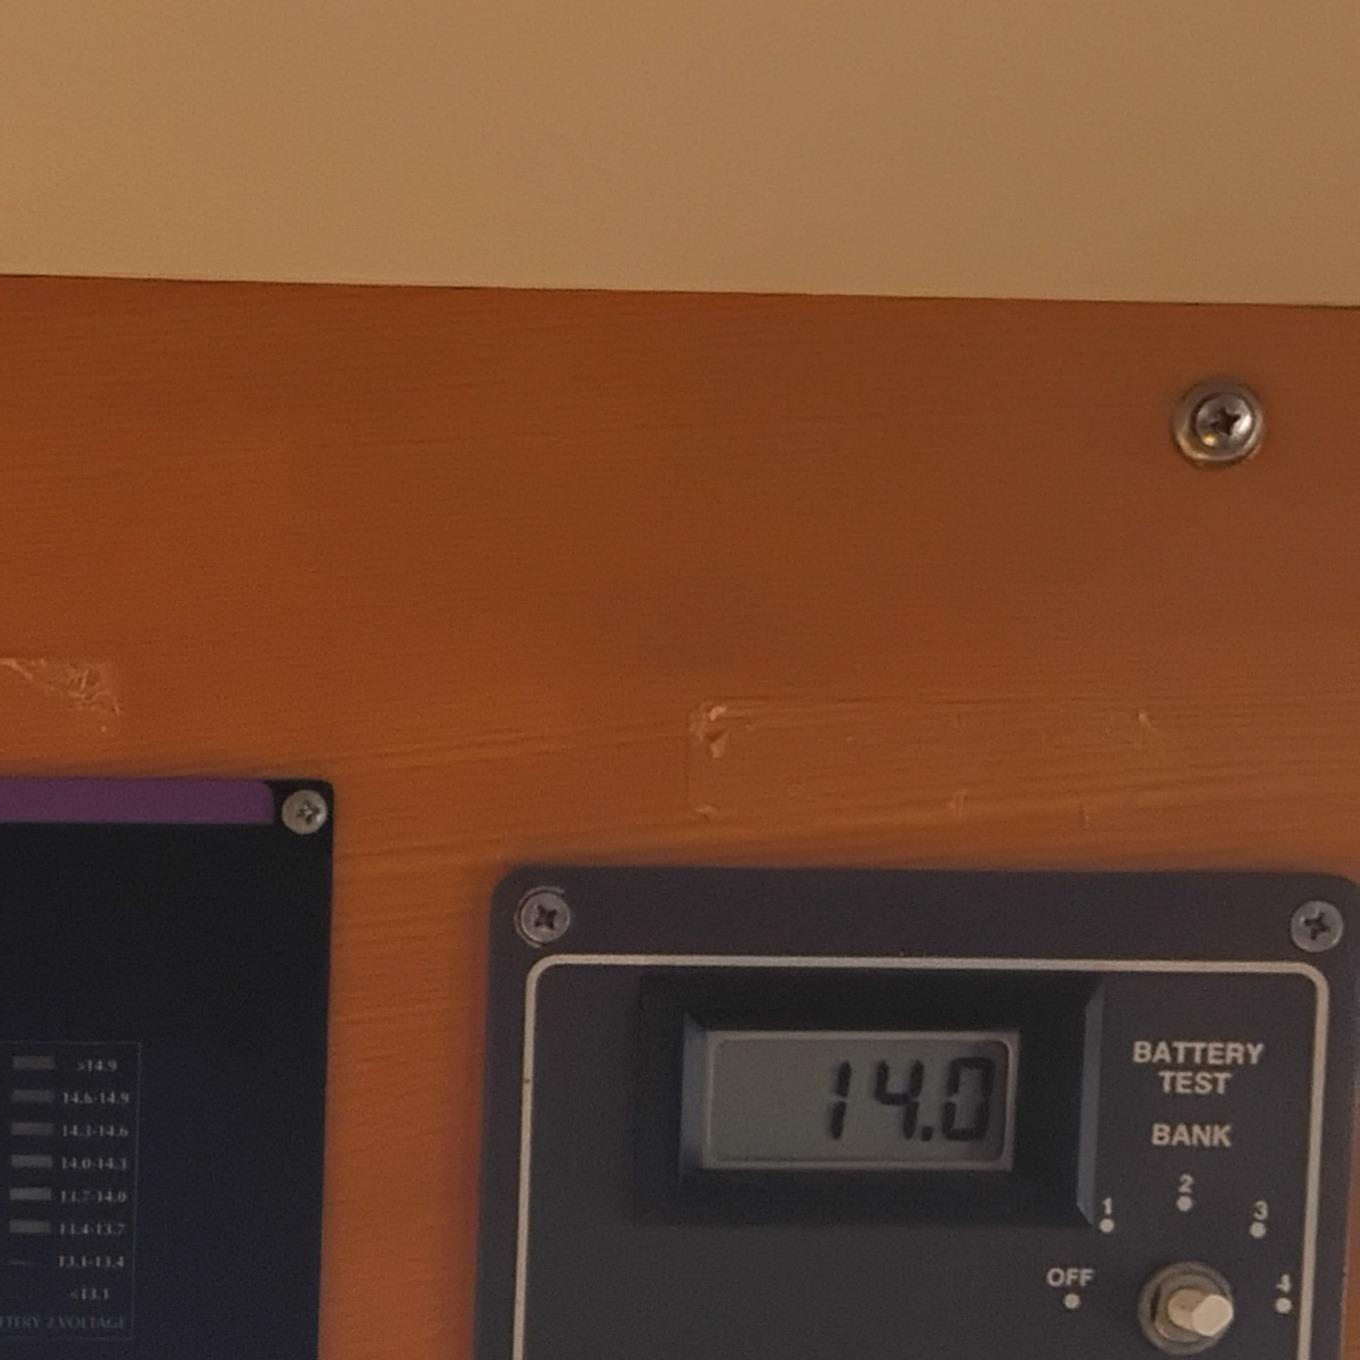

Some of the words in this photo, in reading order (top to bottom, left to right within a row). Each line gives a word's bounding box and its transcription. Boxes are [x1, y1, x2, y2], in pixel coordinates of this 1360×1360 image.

[1133, 1041, 1264, 1065] BATTERY
[1159, 1071, 1232, 1094] TEST
[825, 1056, 996, 1144] 14.0
[1152, 1123, 1231, 1147] BANK
[1179, 1174, 1193, 1193] 2
[1103, 1198, 1112, 1215] 1
[1254, 1200, 1268, 1220] 3
[1047, 1268, 1093, 1287] OFF
[1277, 1274, 1291, 1292] 4
